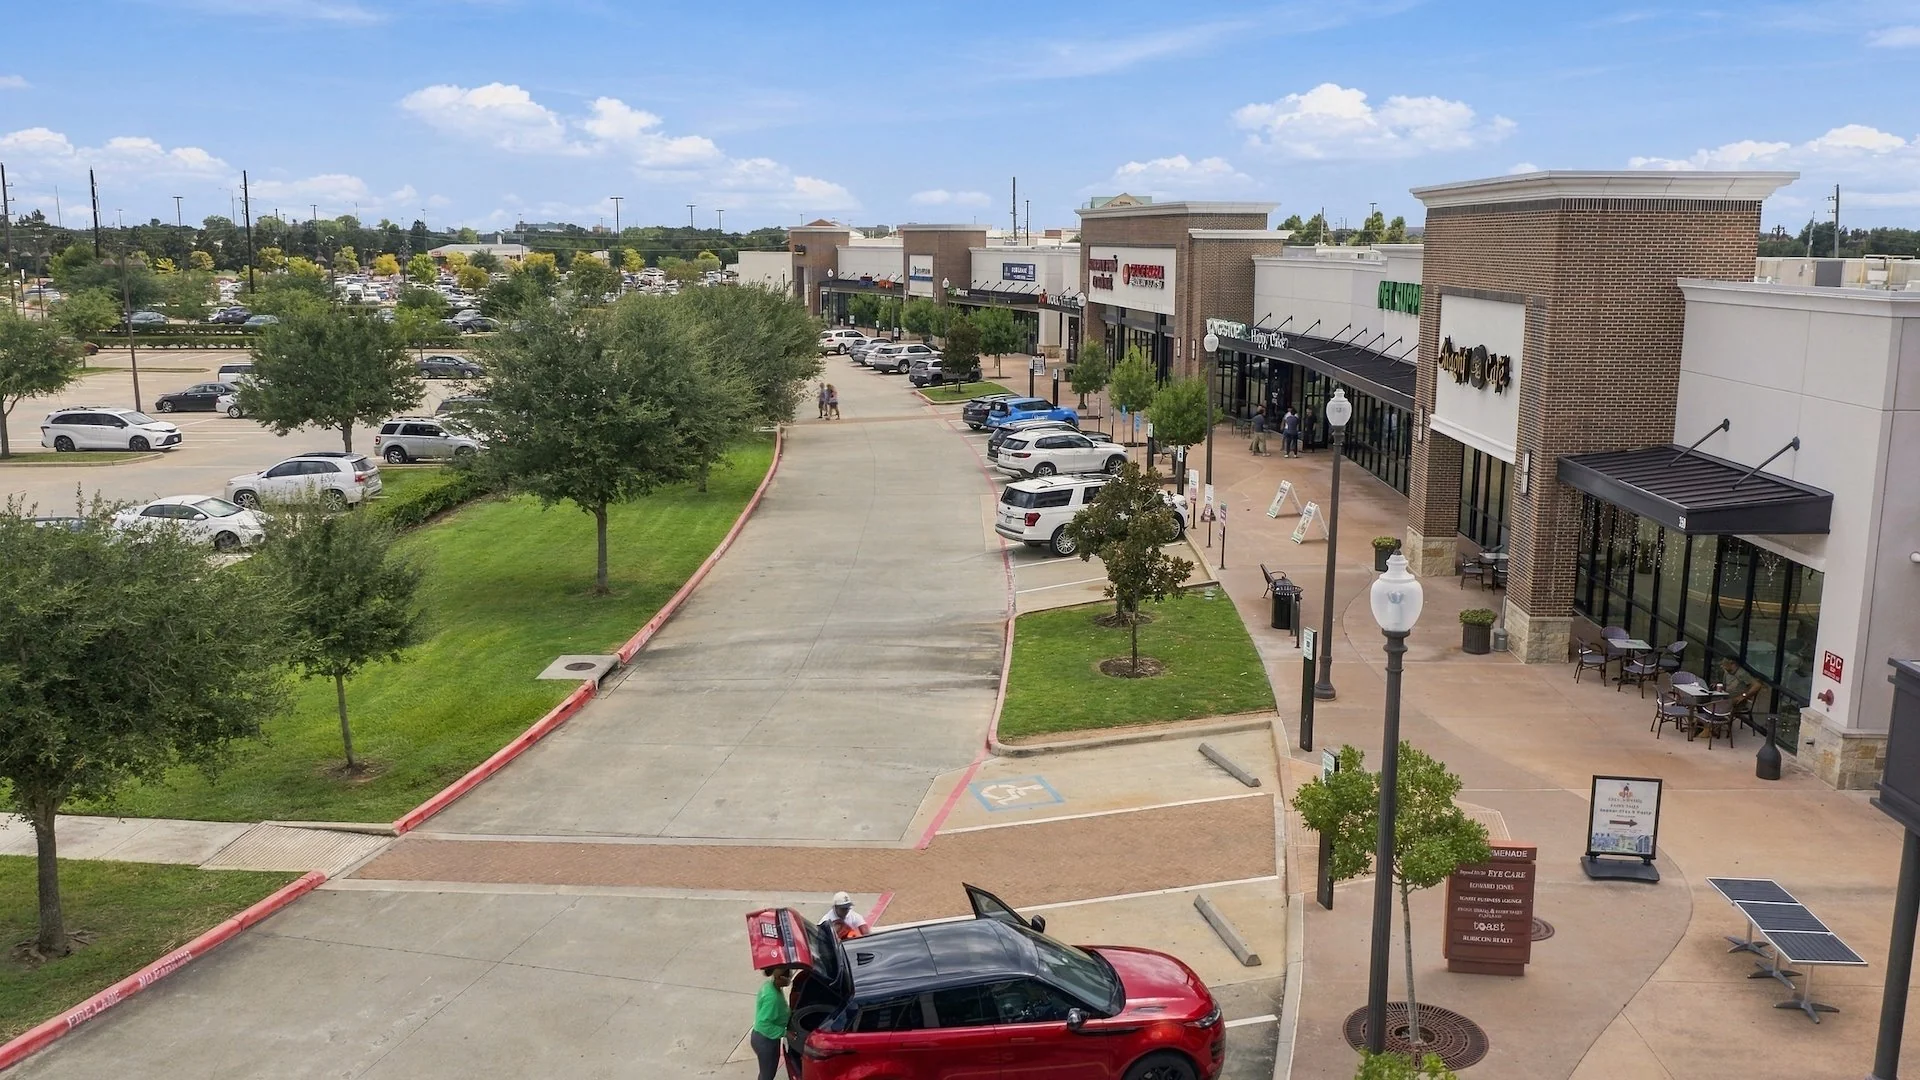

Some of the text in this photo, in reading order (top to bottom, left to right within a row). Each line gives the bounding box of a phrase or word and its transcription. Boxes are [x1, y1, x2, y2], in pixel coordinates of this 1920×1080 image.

[1378, 280, 1396, 310] PET
[1825, 652, 1842, 670] FDC
[1491, 850, 1528, 858] MENADE
[1488, 869, 1503, 878] EYE
[1504, 870, 1526, 879] CARE
[1473, 921, 1505, 932] toast
[67, 950, 192, 1028] FIRE LANE NO PARKING
